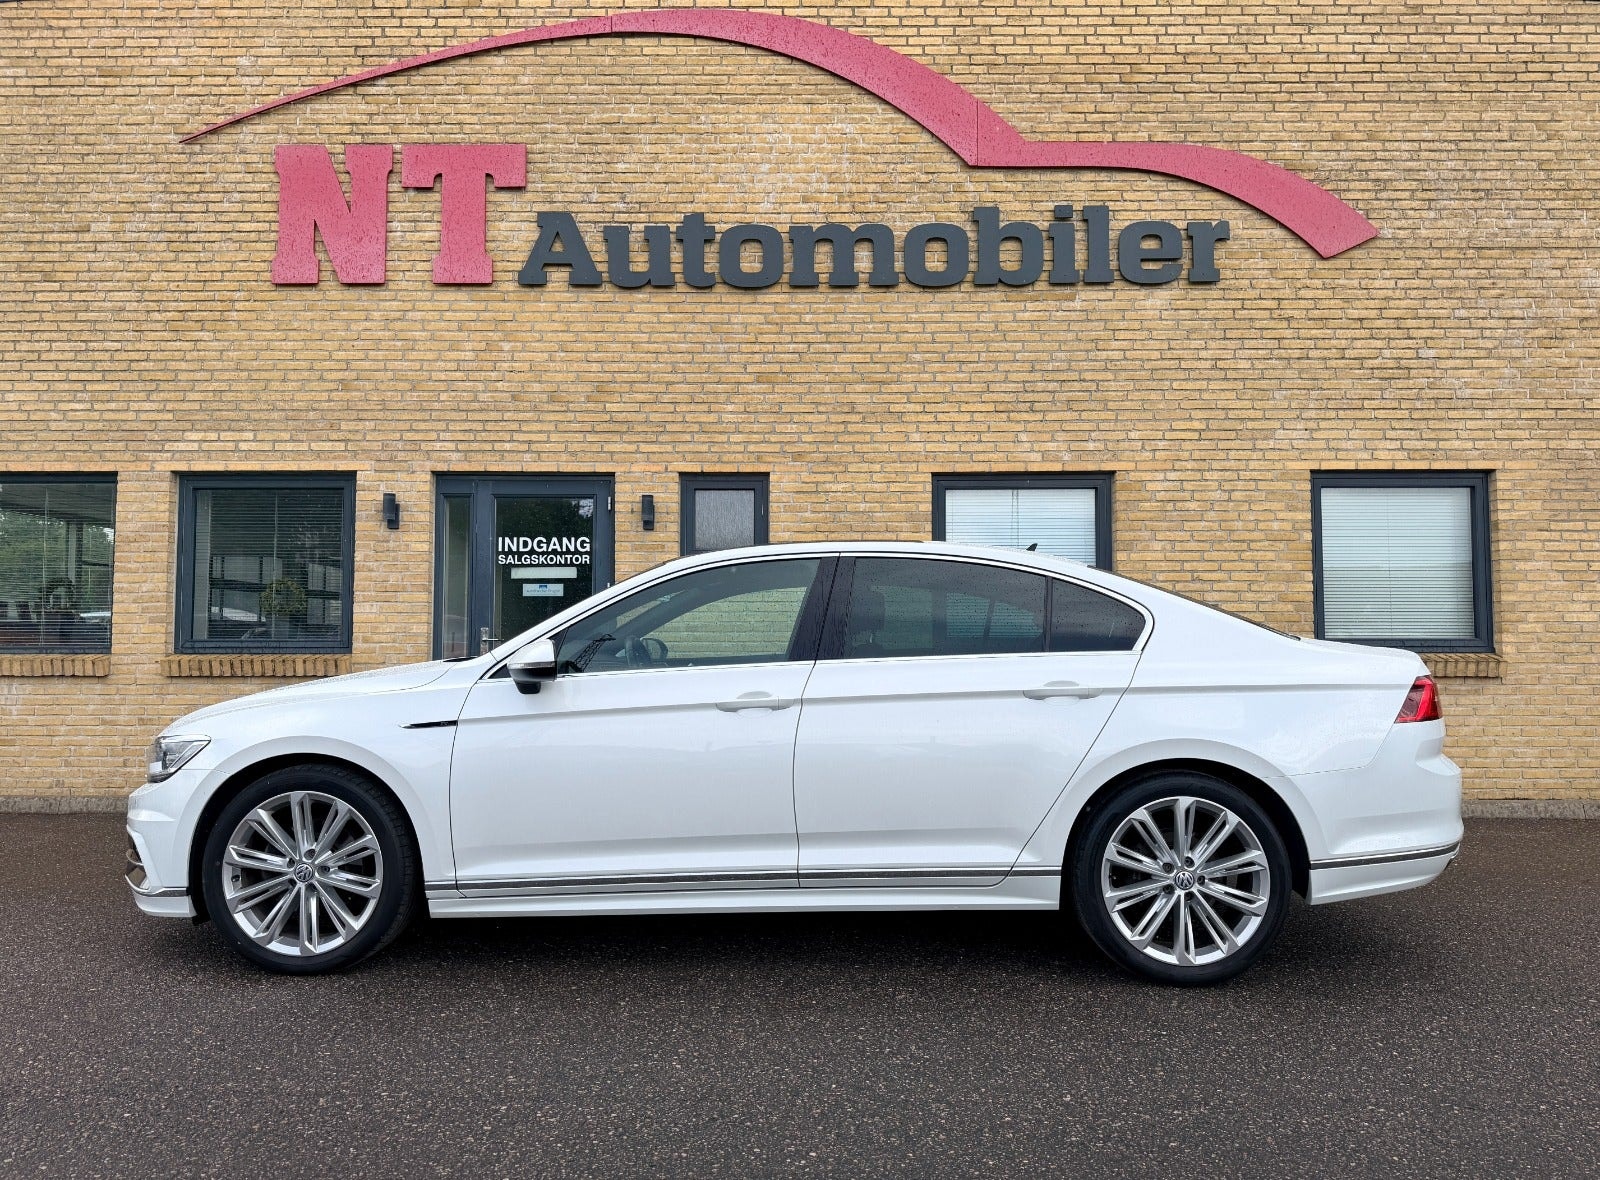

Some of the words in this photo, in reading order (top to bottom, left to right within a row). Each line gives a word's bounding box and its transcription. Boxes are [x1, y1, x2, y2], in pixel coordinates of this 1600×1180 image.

[271, 143, 527, 286] NT
[517, 204, 1230, 289] Automobiler
[498, 536, 591, 552] INDGANG
[498, 554, 590, 565] SALGSKONTOR
